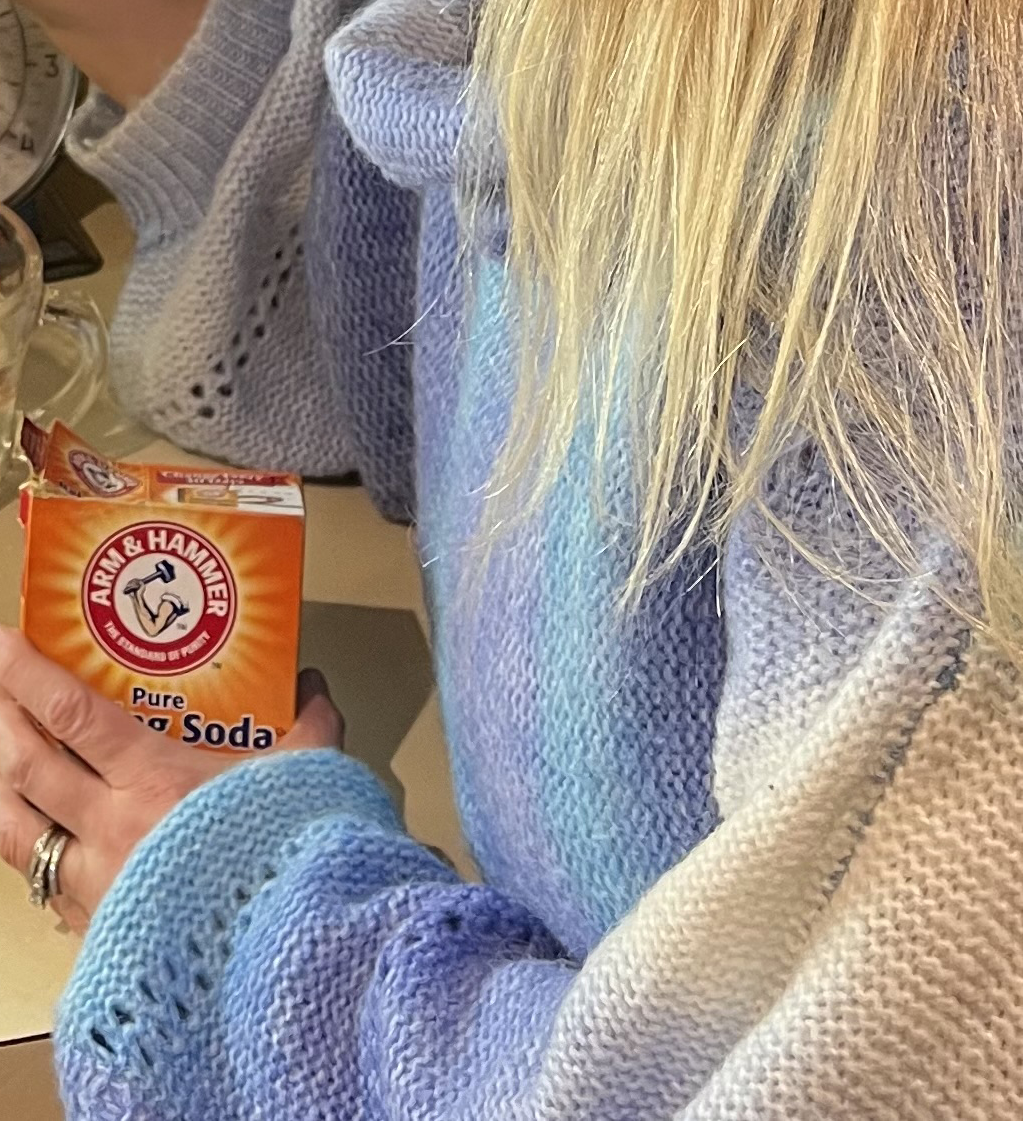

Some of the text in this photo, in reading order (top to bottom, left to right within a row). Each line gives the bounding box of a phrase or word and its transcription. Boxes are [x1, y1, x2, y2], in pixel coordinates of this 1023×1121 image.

[43, 53, 60, 78] 3
[89, 529, 229, 618] ARM & HAMMER
[132, 687, 185, 710] Pure
[182, 714, 273, 750] Soda
